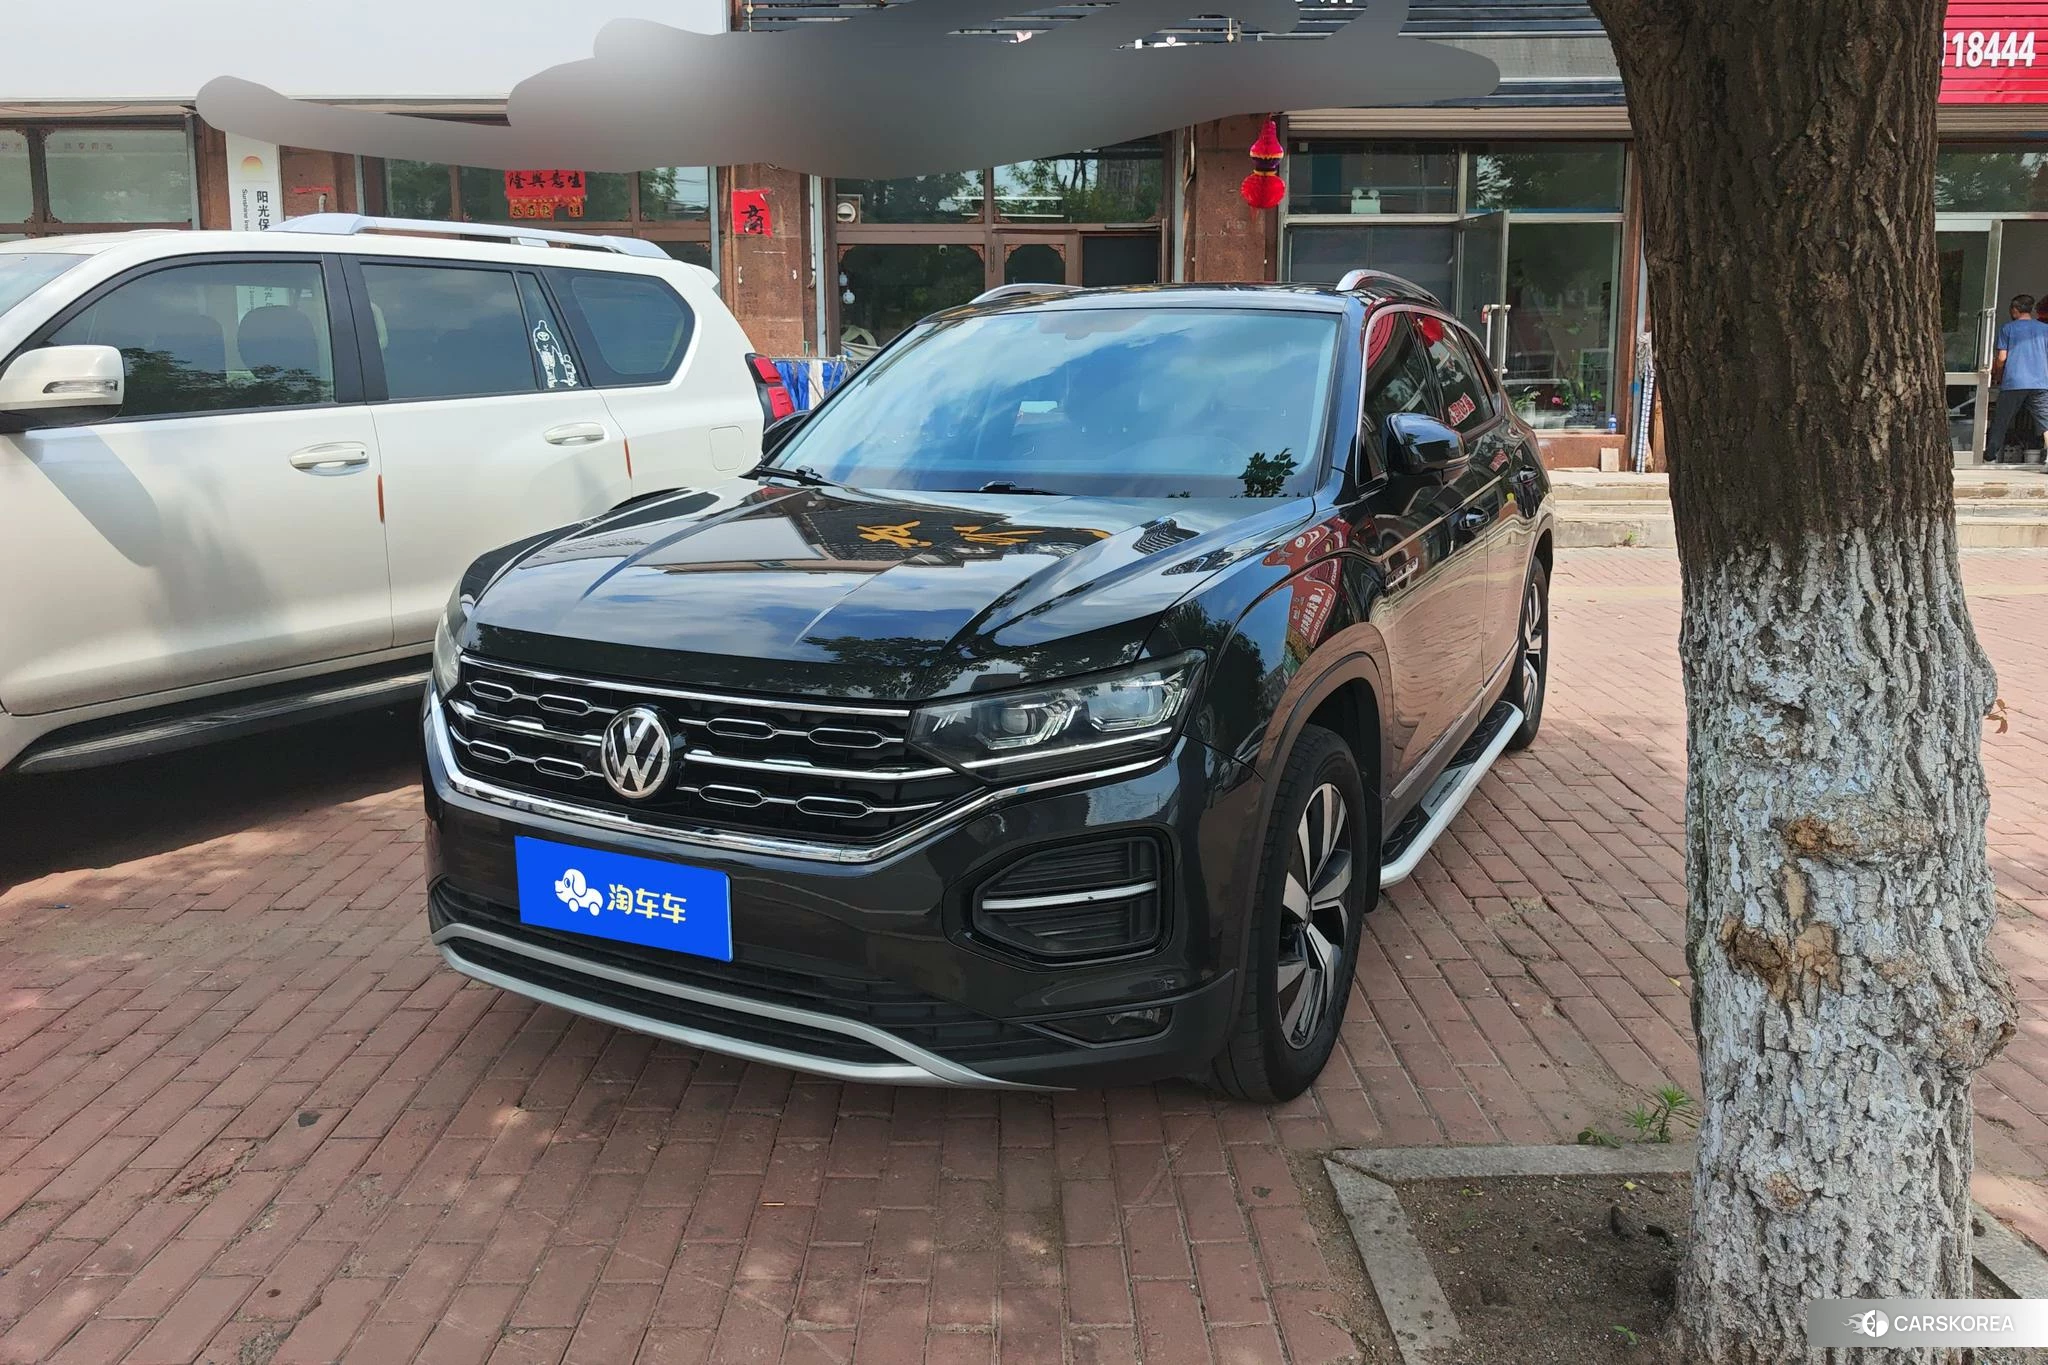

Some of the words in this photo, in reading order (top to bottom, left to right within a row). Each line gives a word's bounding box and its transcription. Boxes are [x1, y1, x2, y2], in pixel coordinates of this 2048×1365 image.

[257, 191, 270, 230] 阳光保
[606, 883, 687, 924] 淘车车
